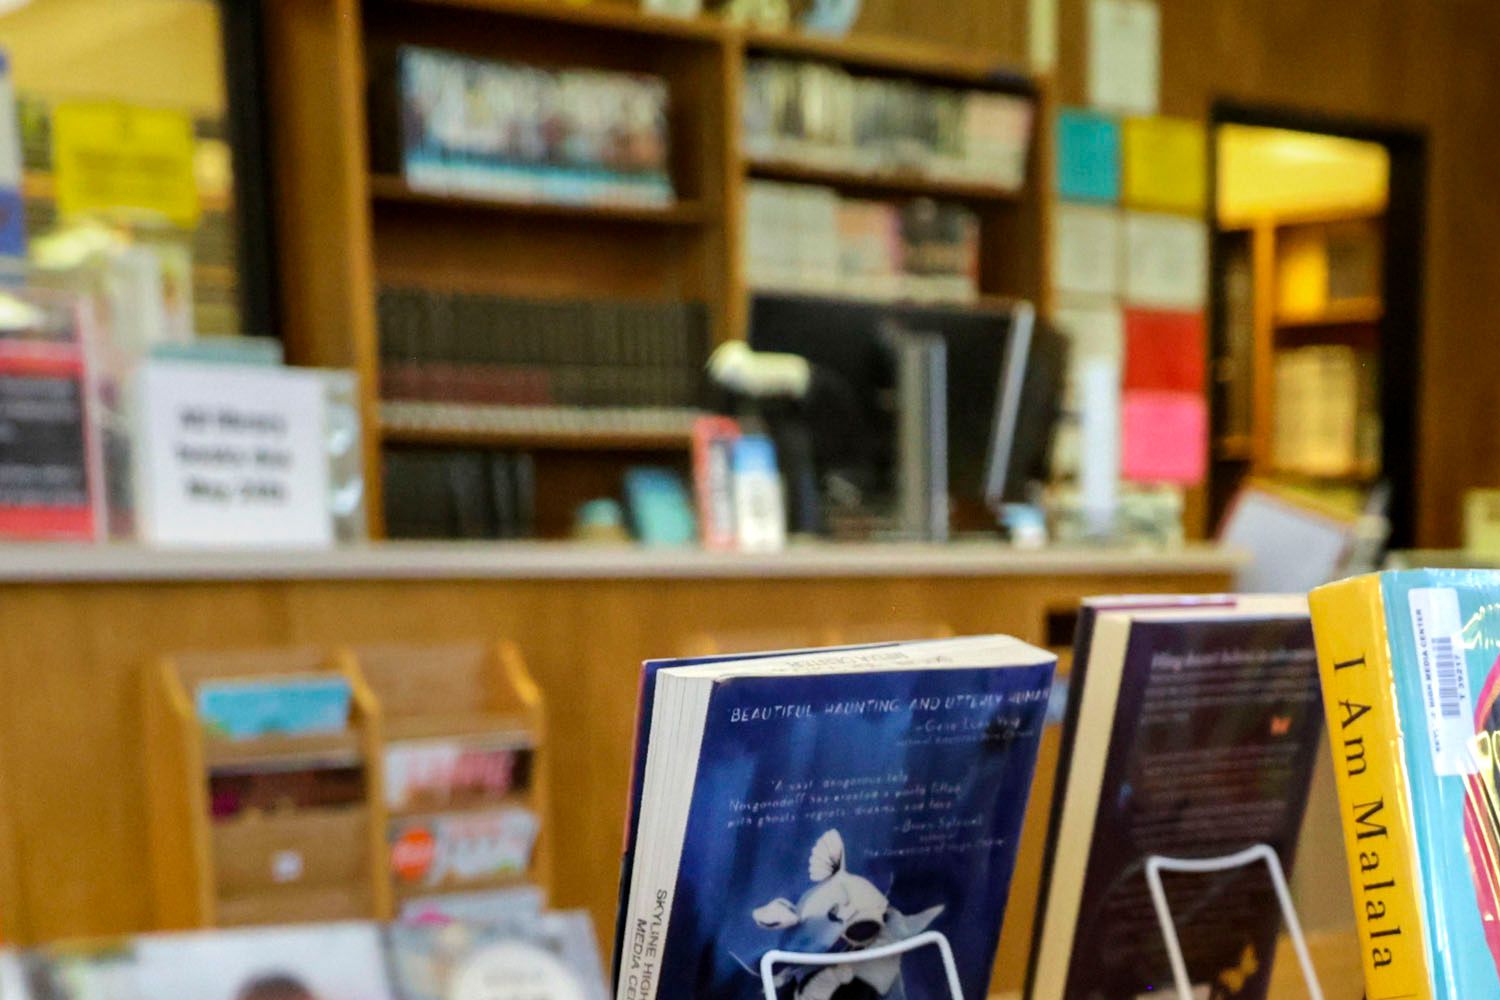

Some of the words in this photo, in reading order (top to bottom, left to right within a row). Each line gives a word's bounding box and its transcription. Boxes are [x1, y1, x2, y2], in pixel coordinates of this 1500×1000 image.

[1416, 609, 1428, 648] CENTER
[1334, 656, 1366, 671] I
[1422, 649, 1432, 681] MEDIA
[909, 698, 939, 711] AND
[1338, 699, 1372, 778] Am
[1352, 797, 1401, 970] Malala
[631, 918, 647, 970] MEDIA
[645, 889, 667, 958] SKYLINE
